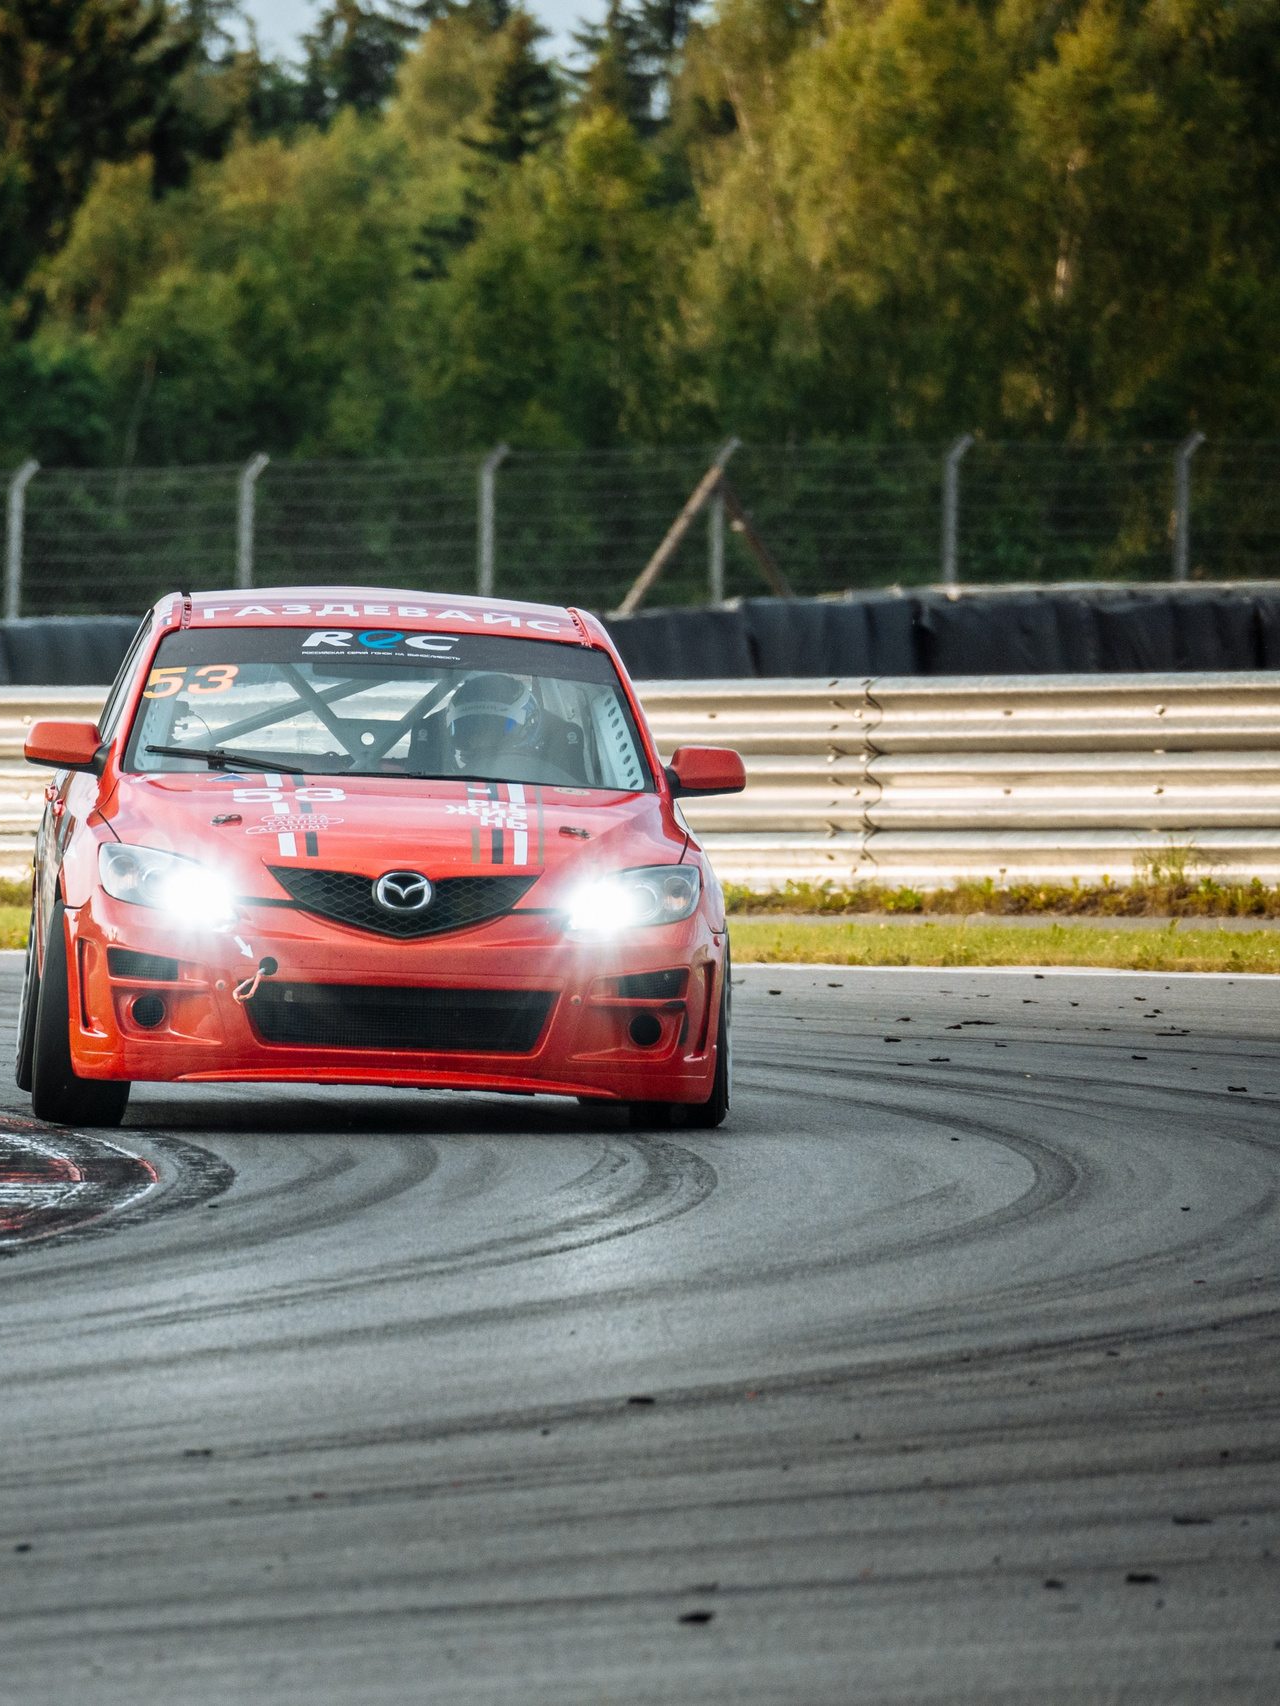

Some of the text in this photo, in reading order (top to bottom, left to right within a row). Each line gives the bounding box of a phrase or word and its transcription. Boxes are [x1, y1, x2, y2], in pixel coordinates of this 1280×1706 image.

[203, 604, 560, 633] ГАЗДЕВАЙС
[143, 664, 239, 699] 53
[232, 787, 347, 803] 53
[259, 824, 329, 833] ACADEMY
